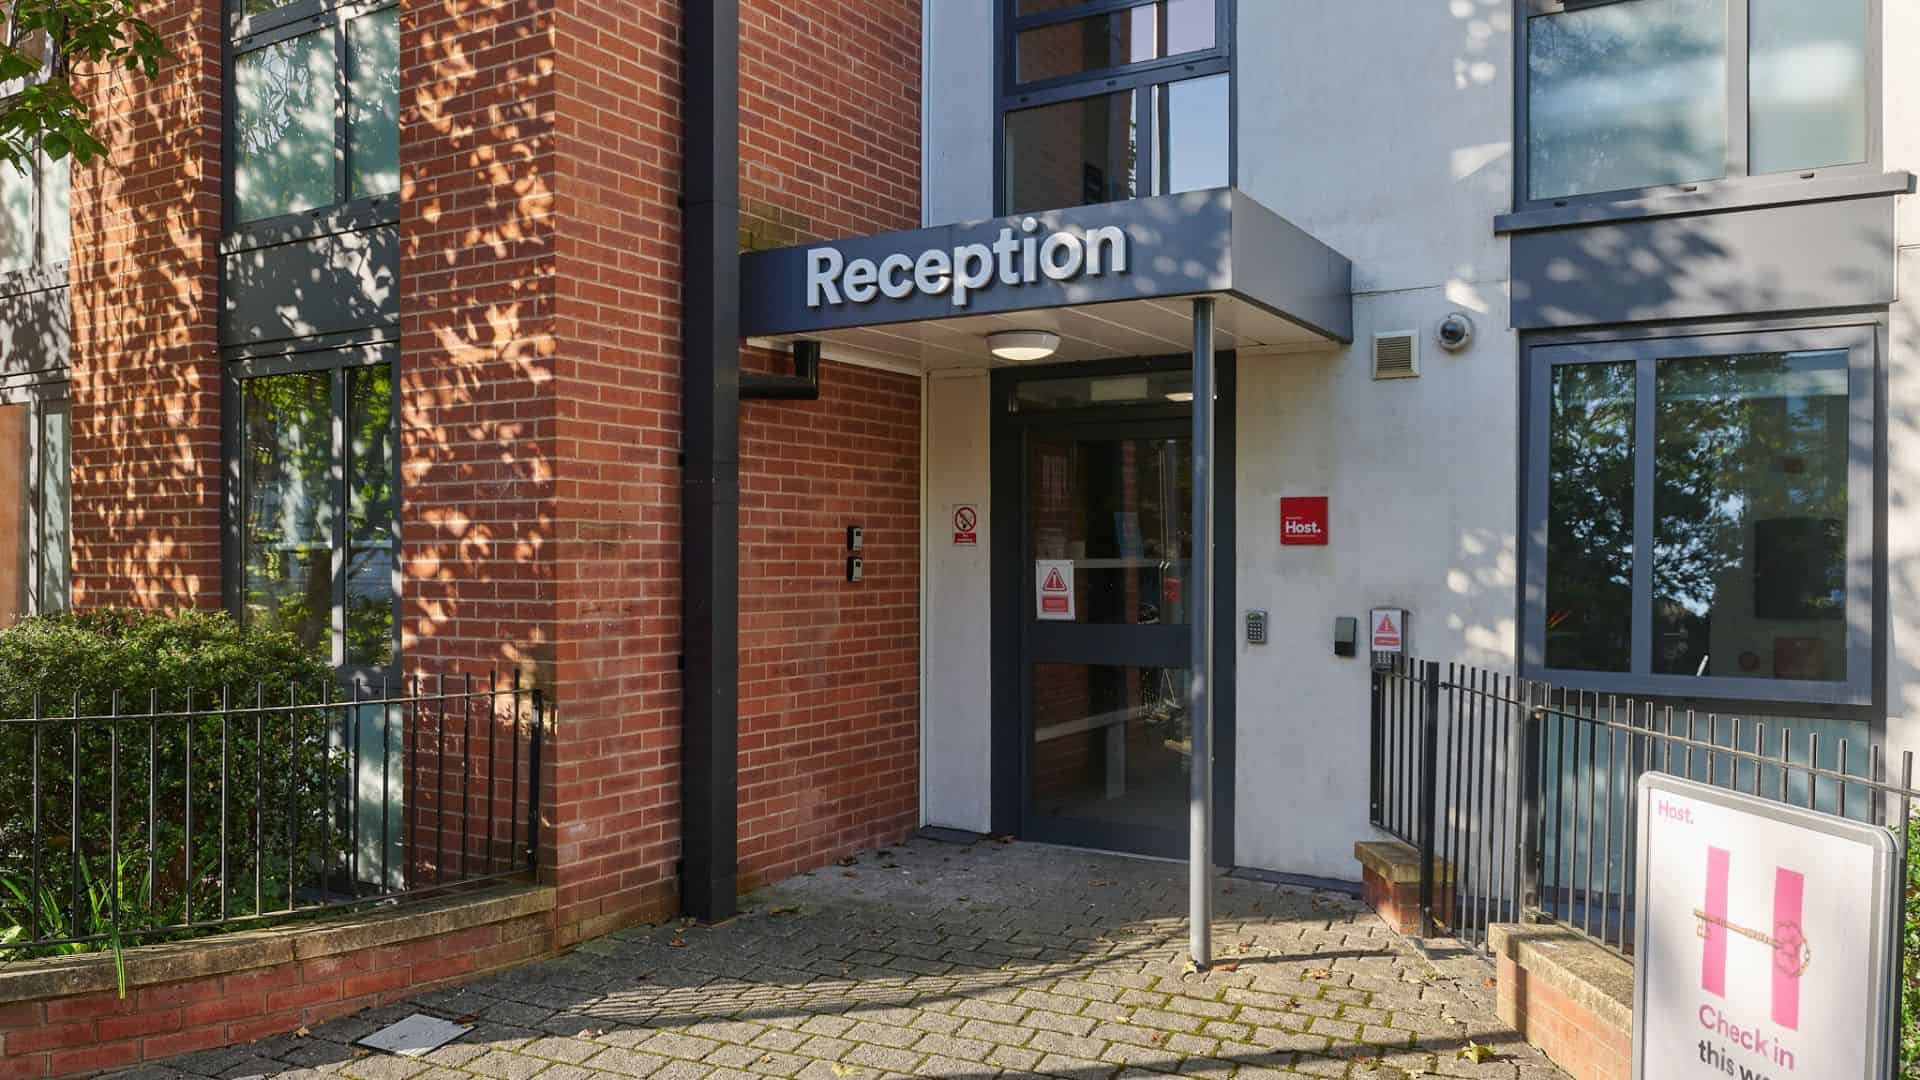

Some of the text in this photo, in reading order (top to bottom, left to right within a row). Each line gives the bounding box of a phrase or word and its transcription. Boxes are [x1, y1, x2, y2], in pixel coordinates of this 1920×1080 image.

[807, 216, 1127, 307] Reception
[1285, 520, 1321, 534] Host.
[1658, 799, 1694, 825] Host.
[1698, 1004, 1795, 1072] Check in
[1698, 1039, 1735, 1076] this
